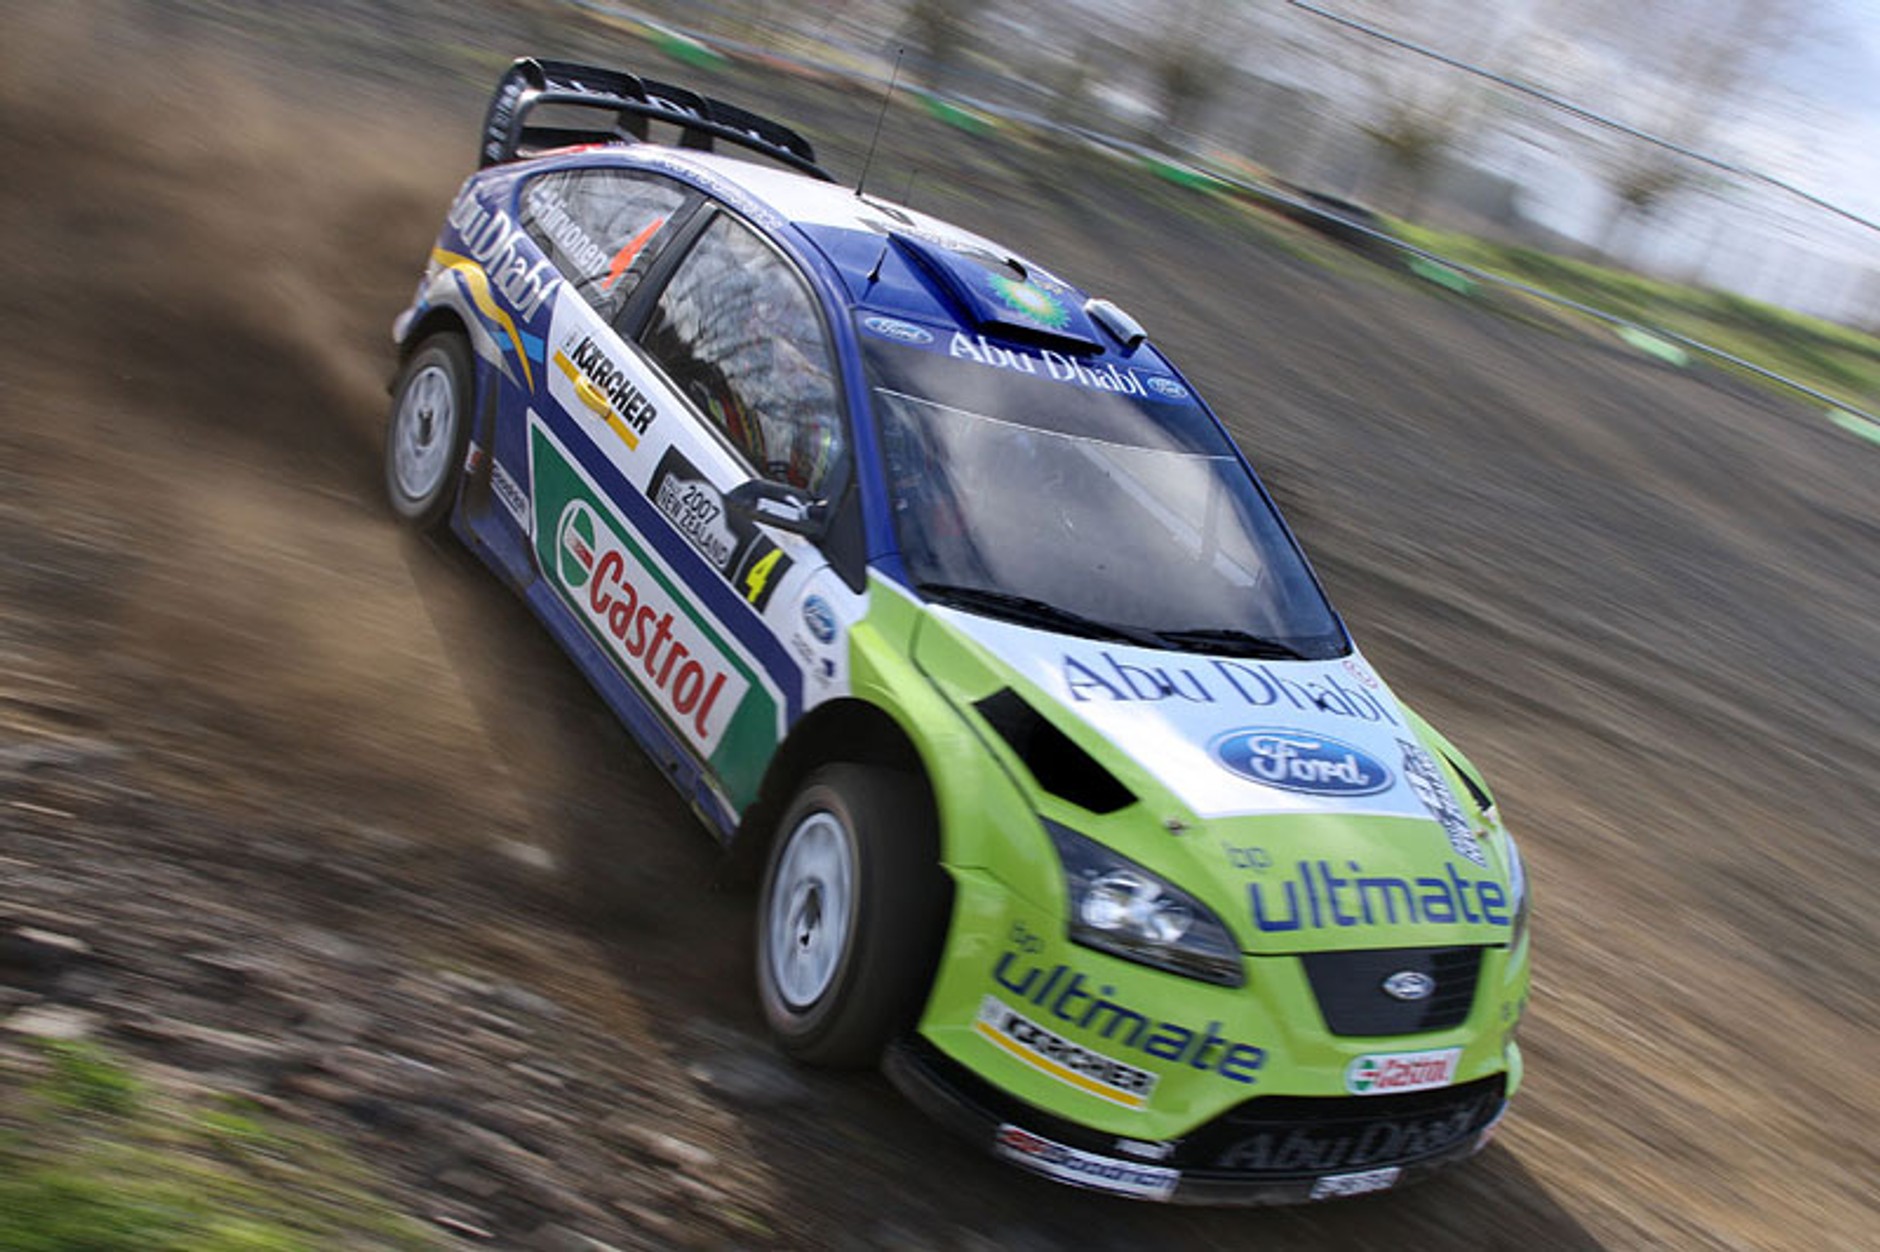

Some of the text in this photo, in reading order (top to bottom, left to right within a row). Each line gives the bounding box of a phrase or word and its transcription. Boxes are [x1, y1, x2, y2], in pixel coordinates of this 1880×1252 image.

[571, 336, 656, 435] KÄRCHER
[950, 331, 1148, 397] Abu Dhabi
[657, 486, 729, 567] NEW ZEALAND
[682, 485, 720, 525] 2007
[745, 548, 784, 603] 4
[590, 550, 728, 739] Castrol
[1064, 651, 1215, 702] Abu
[1210, 659, 1398, 726] Dhabi
[1246, 735, 1370, 787] Ford
[1248, 860, 1510, 932] ultimate
[993, 952, 1266, 1083] ultimate
